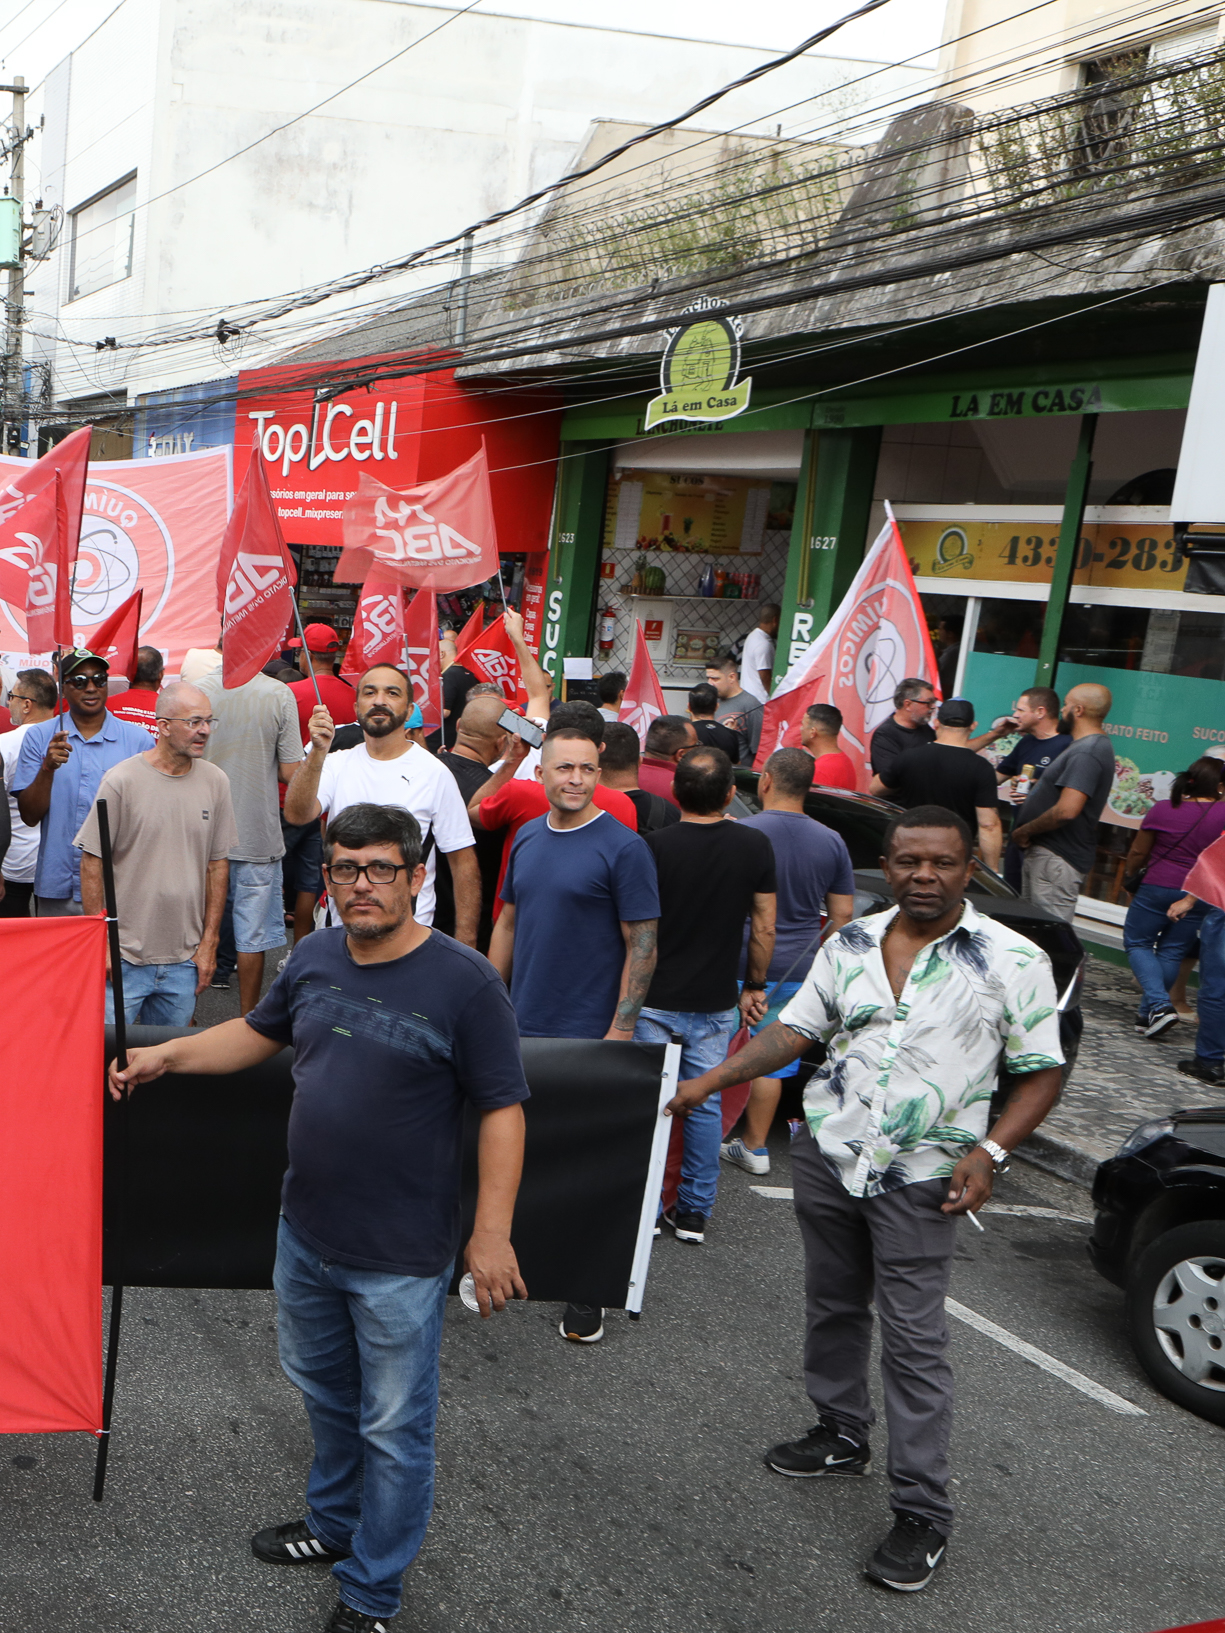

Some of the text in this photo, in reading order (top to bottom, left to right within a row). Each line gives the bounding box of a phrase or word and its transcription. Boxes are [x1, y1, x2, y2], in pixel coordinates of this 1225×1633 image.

[662, 396, 738, 414] Lá em Casa
[949, 385, 1103, 418] LA EM CASA
[306, 489, 326, 502] geral
[1101, 723, 1169, 744] PRATO FEITO
